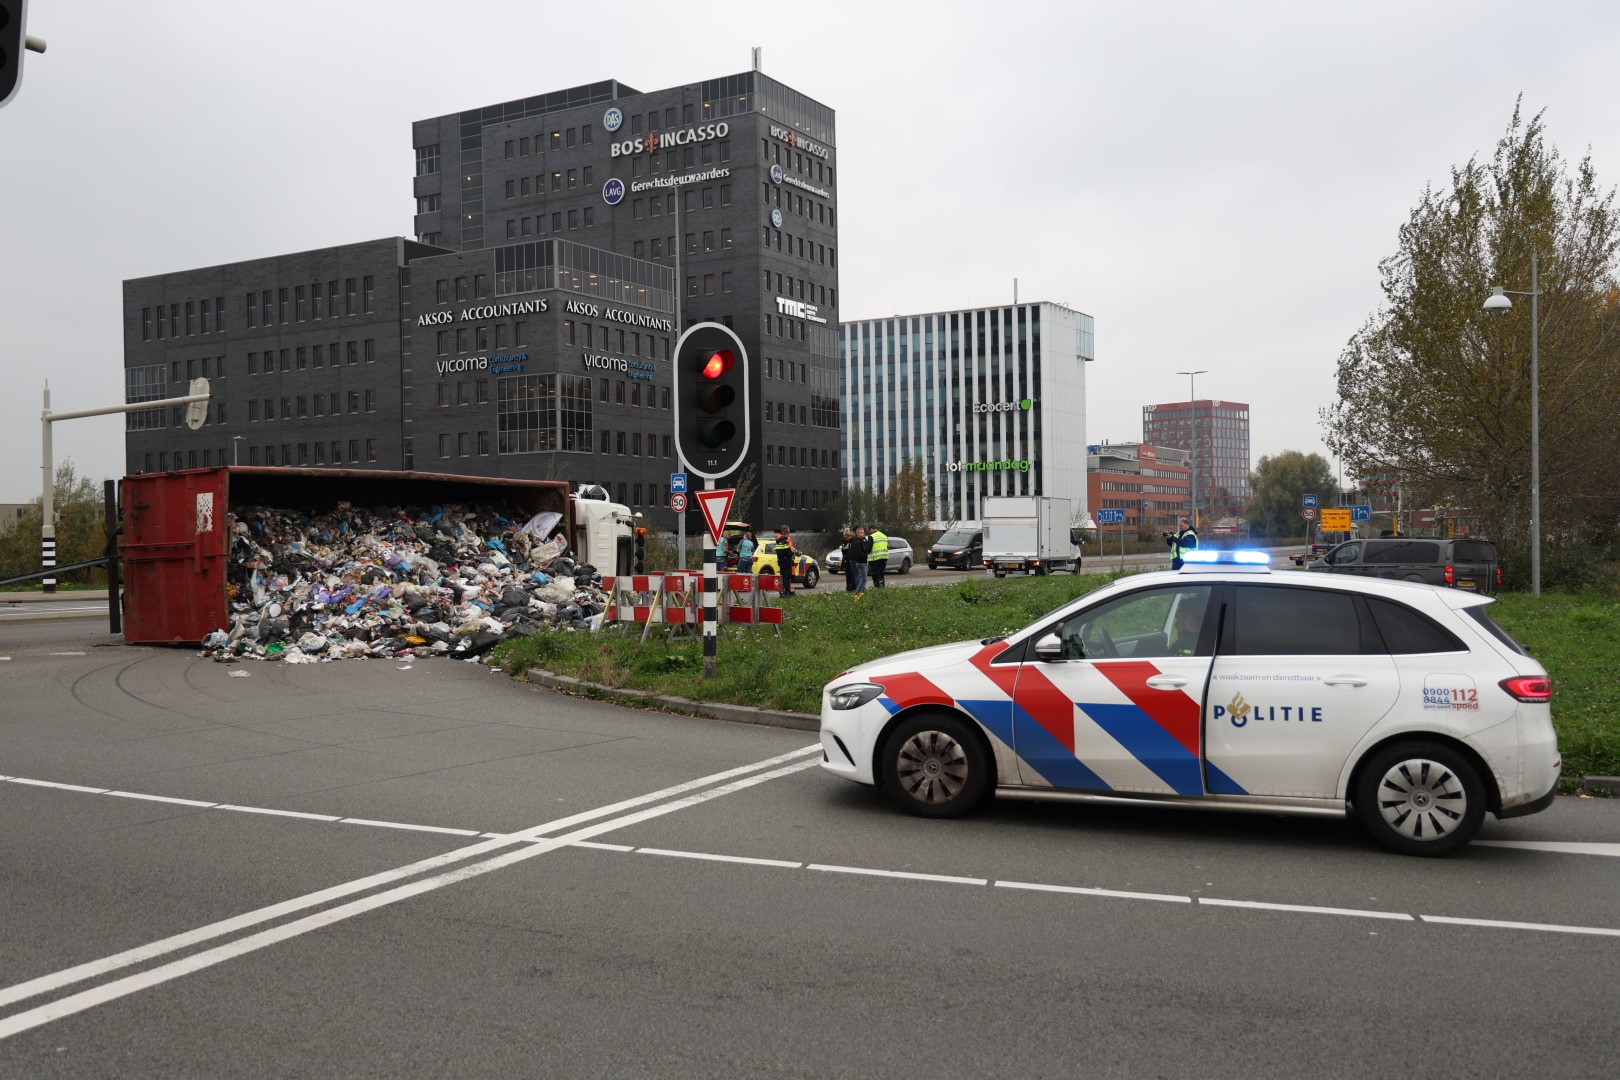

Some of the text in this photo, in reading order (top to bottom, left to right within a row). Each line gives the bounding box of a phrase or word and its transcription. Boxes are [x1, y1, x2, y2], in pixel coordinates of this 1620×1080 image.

[611, 122, 730, 158] BOS INCASSO
[770, 124, 829, 160] BOS INCASSO
[631, 167, 730, 193] Gerechtsdeurwaarders
[605, 186, 622, 198] LAVG
[417, 298, 548, 327] AKSOS ACCOUNTANTS
[776, 296, 805, 319] TMC
[566, 299, 673, 332] AKSOS ACCOUNTANTS
[973, 399, 1021, 413] Ecocert
[1143, 405, 1157, 413] TKP
[674, 499, 684, 507] 50
[1272, 673, 1314, 681] dienstbaar
[1423, 688, 1450, 696] 0900
[1450, 688, 1478, 702] 112
[1423, 696, 1450, 704] 8844
[1451, 702, 1479, 711] spoed
[1214, 705, 1322, 728] POLITIE
